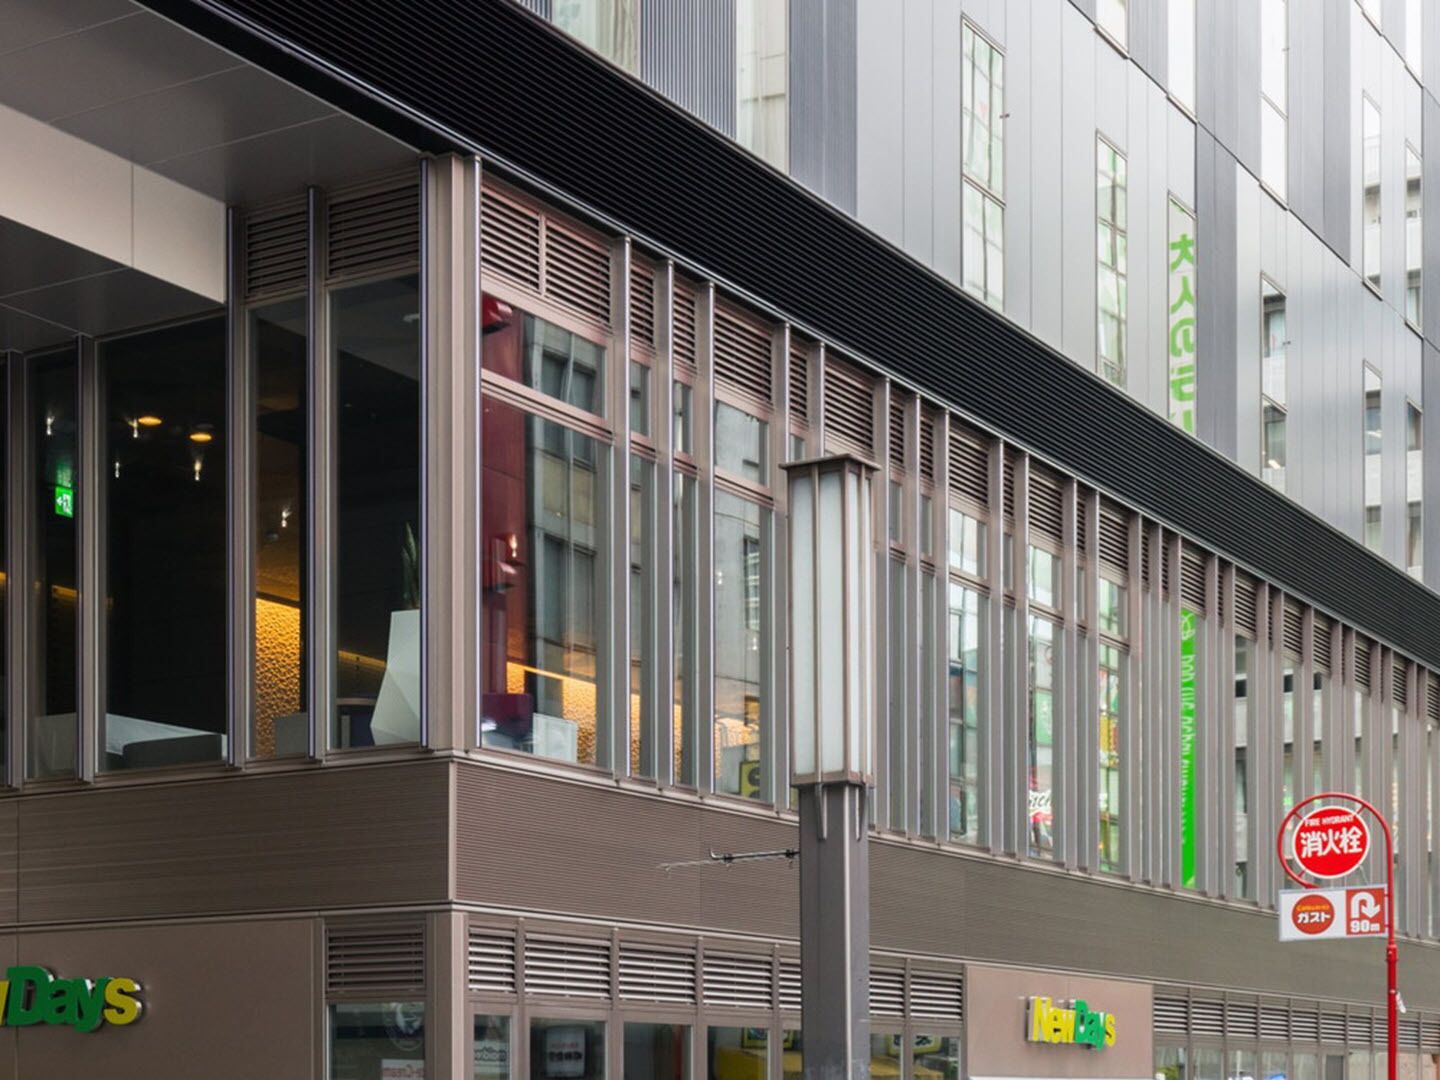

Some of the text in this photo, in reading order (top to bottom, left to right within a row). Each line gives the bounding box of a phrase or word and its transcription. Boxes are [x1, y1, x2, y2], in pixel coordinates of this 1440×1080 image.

[1300, 826, 1363, 858] 消火栓
[1297, 911, 1331, 924] ガスト
[1030, 995, 1116, 1051] NewDays
